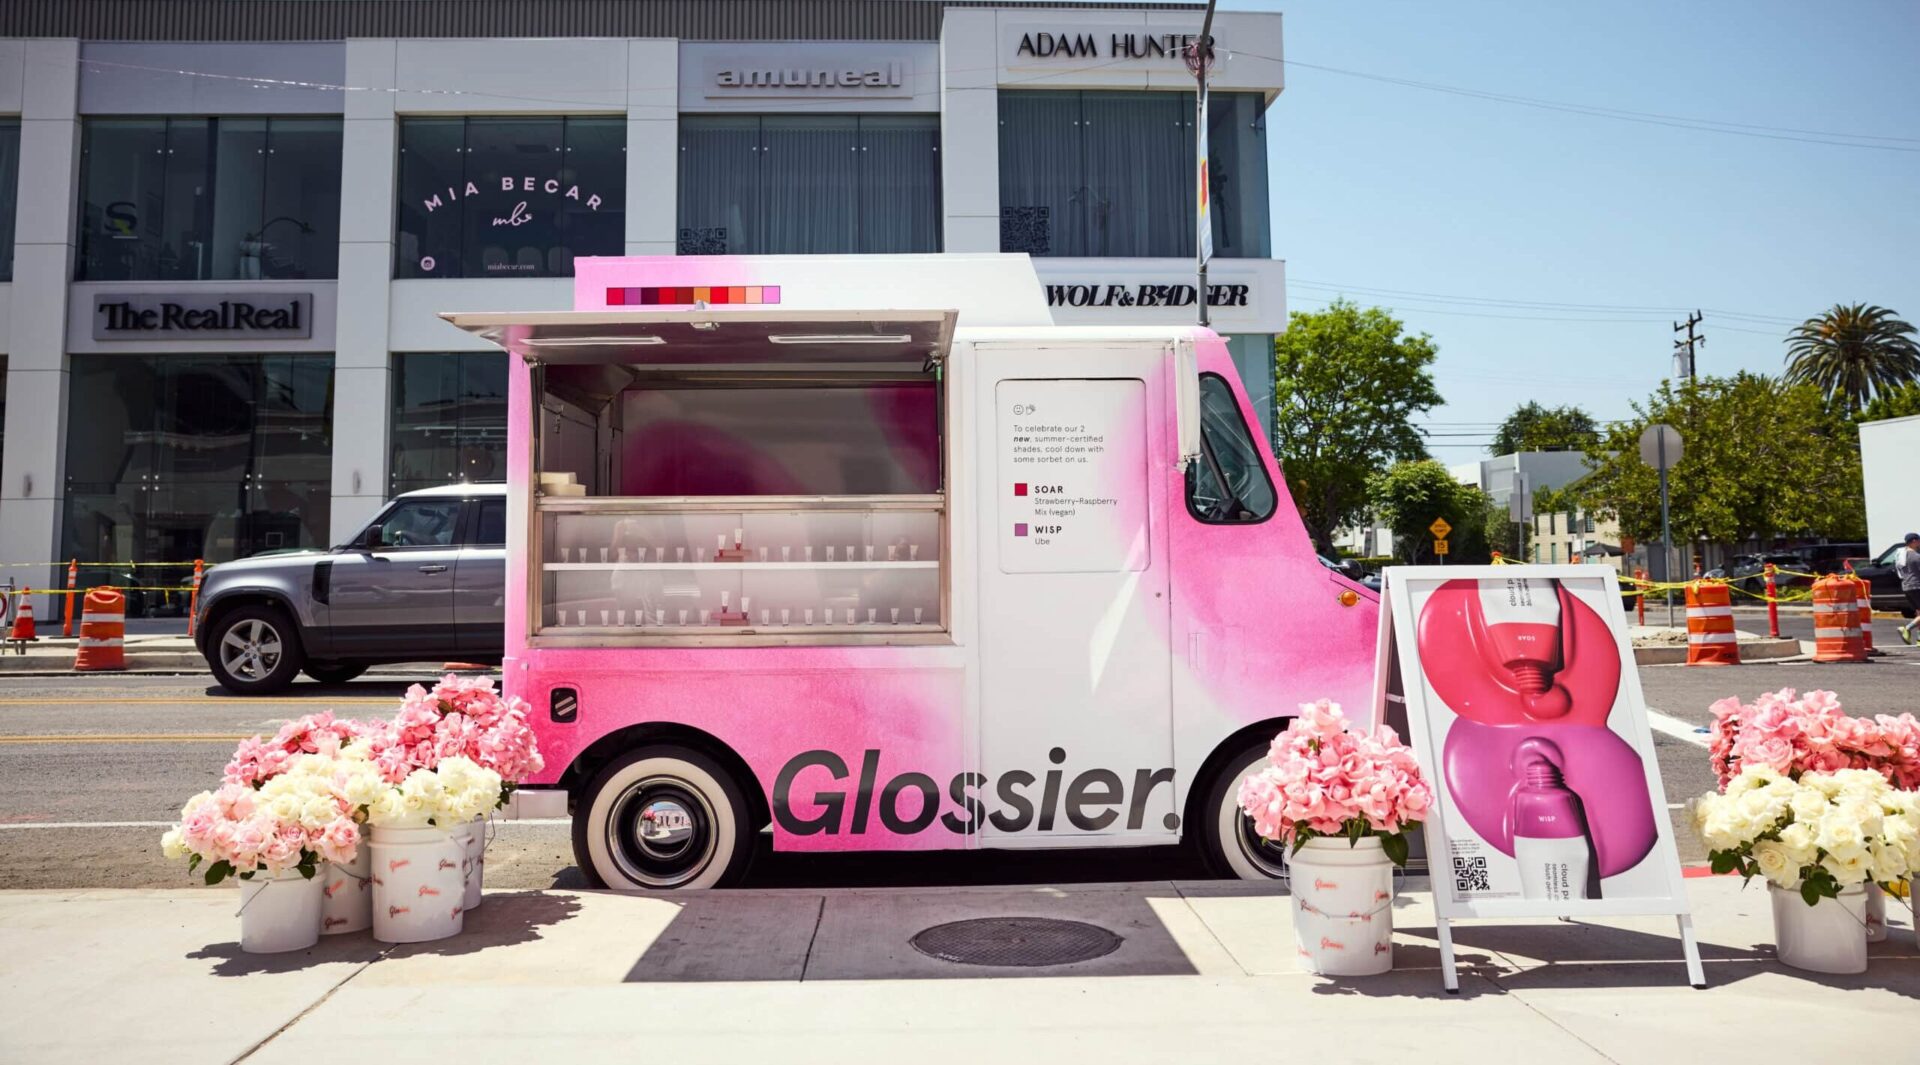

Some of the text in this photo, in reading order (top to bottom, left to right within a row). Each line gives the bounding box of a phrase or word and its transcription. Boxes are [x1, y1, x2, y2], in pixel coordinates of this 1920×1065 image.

[1017, 32, 1097, 58] ADAM
[717, 62, 901, 87] amuneal
[424, 177, 602, 212] MIA BECAR
[1013, 424, 1023, 432] To
[1025, 424, 1062, 432] celebrate
[1035, 435, 1104, 443] summer-certified
[1045, 445, 1062, 453] cool
[1065, 445, 1085, 453] down
[1088, 445, 1104, 453] with
[1034, 485, 1064, 494] SOAR
[1034, 508, 1075, 517] Mix (vegan)
[1034, 525, 1062, 534] WISP
[772, 747, 1181, 836] Glossier.
[1560, 863, 1569, 887] cloud
